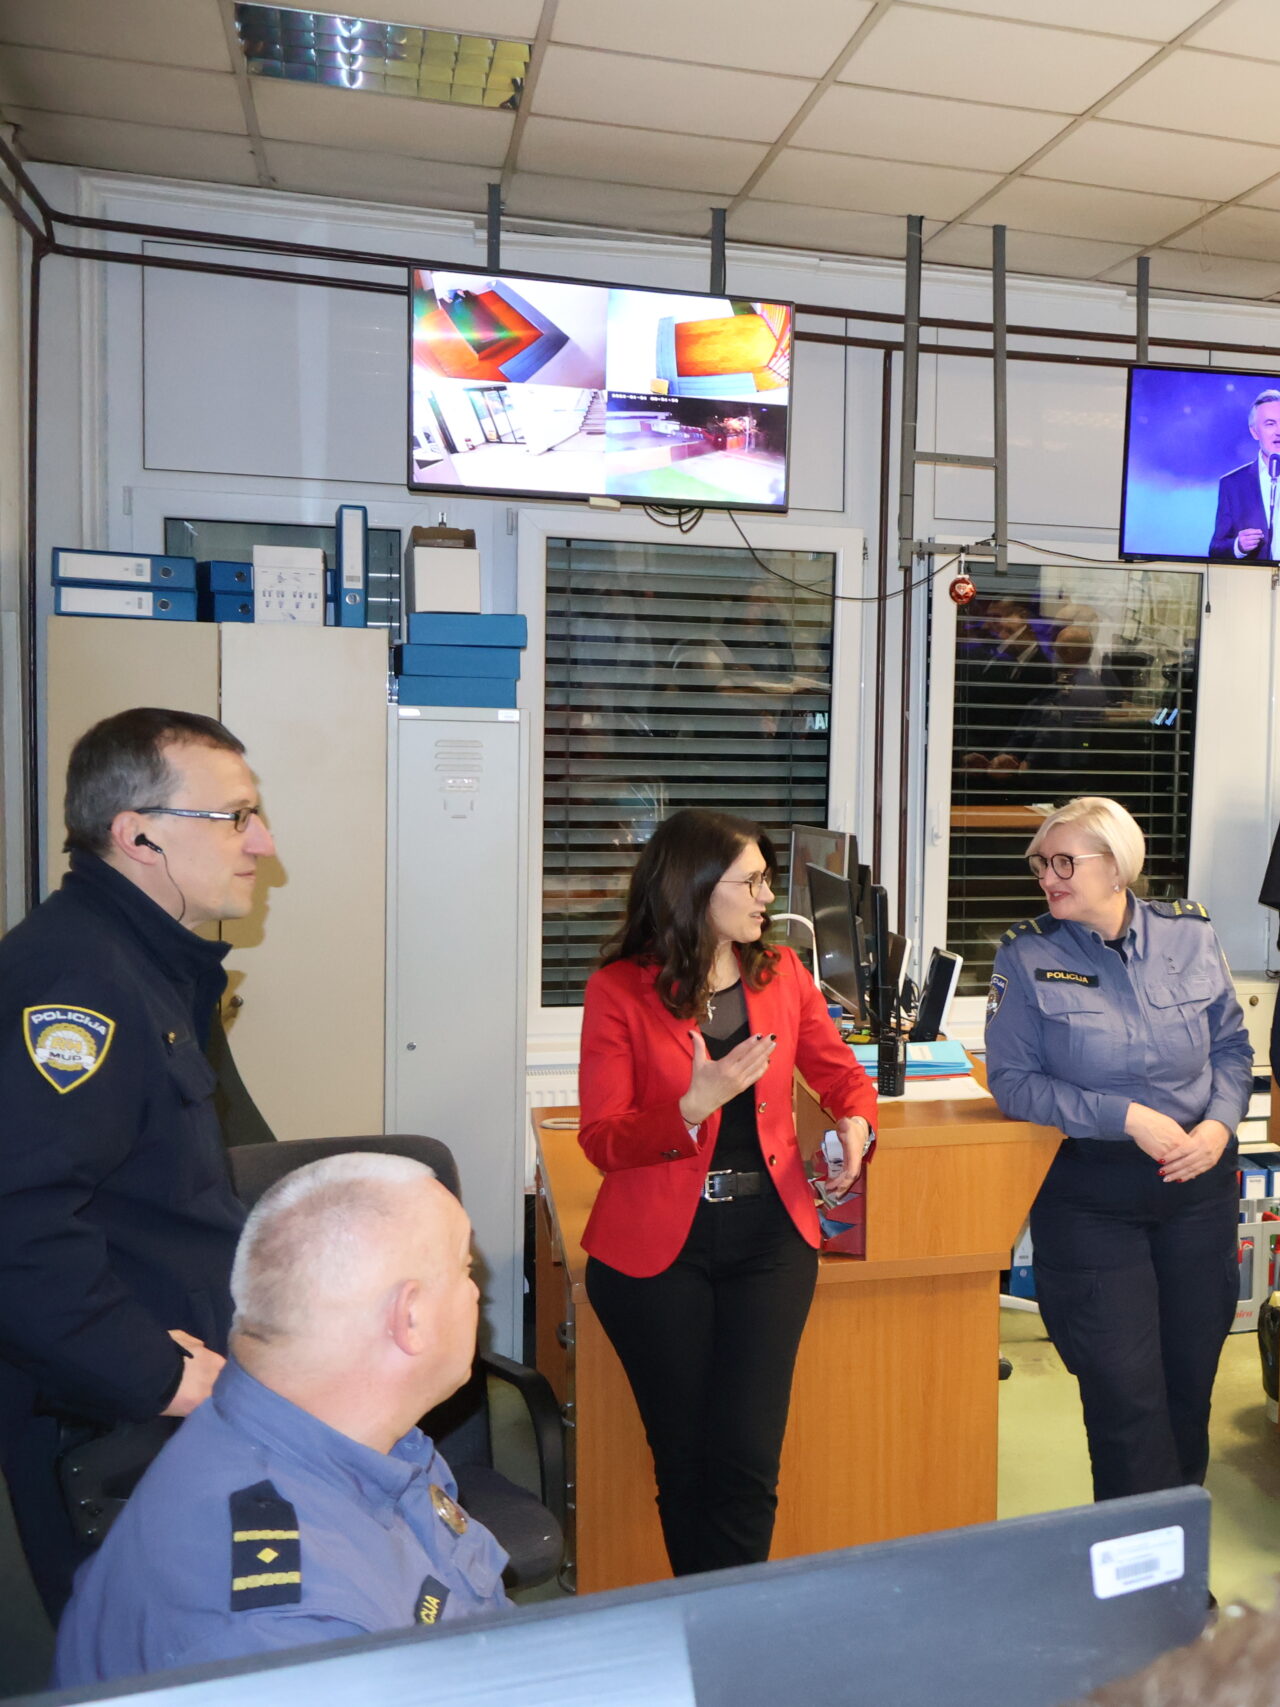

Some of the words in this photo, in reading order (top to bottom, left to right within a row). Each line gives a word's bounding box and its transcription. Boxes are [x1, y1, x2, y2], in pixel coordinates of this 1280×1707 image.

[1046, 971, 1089, 984] POLICIJA
[31, 1010, 107, 1036] POLICIJA
[49, 1051, 83, 1062] MUP
